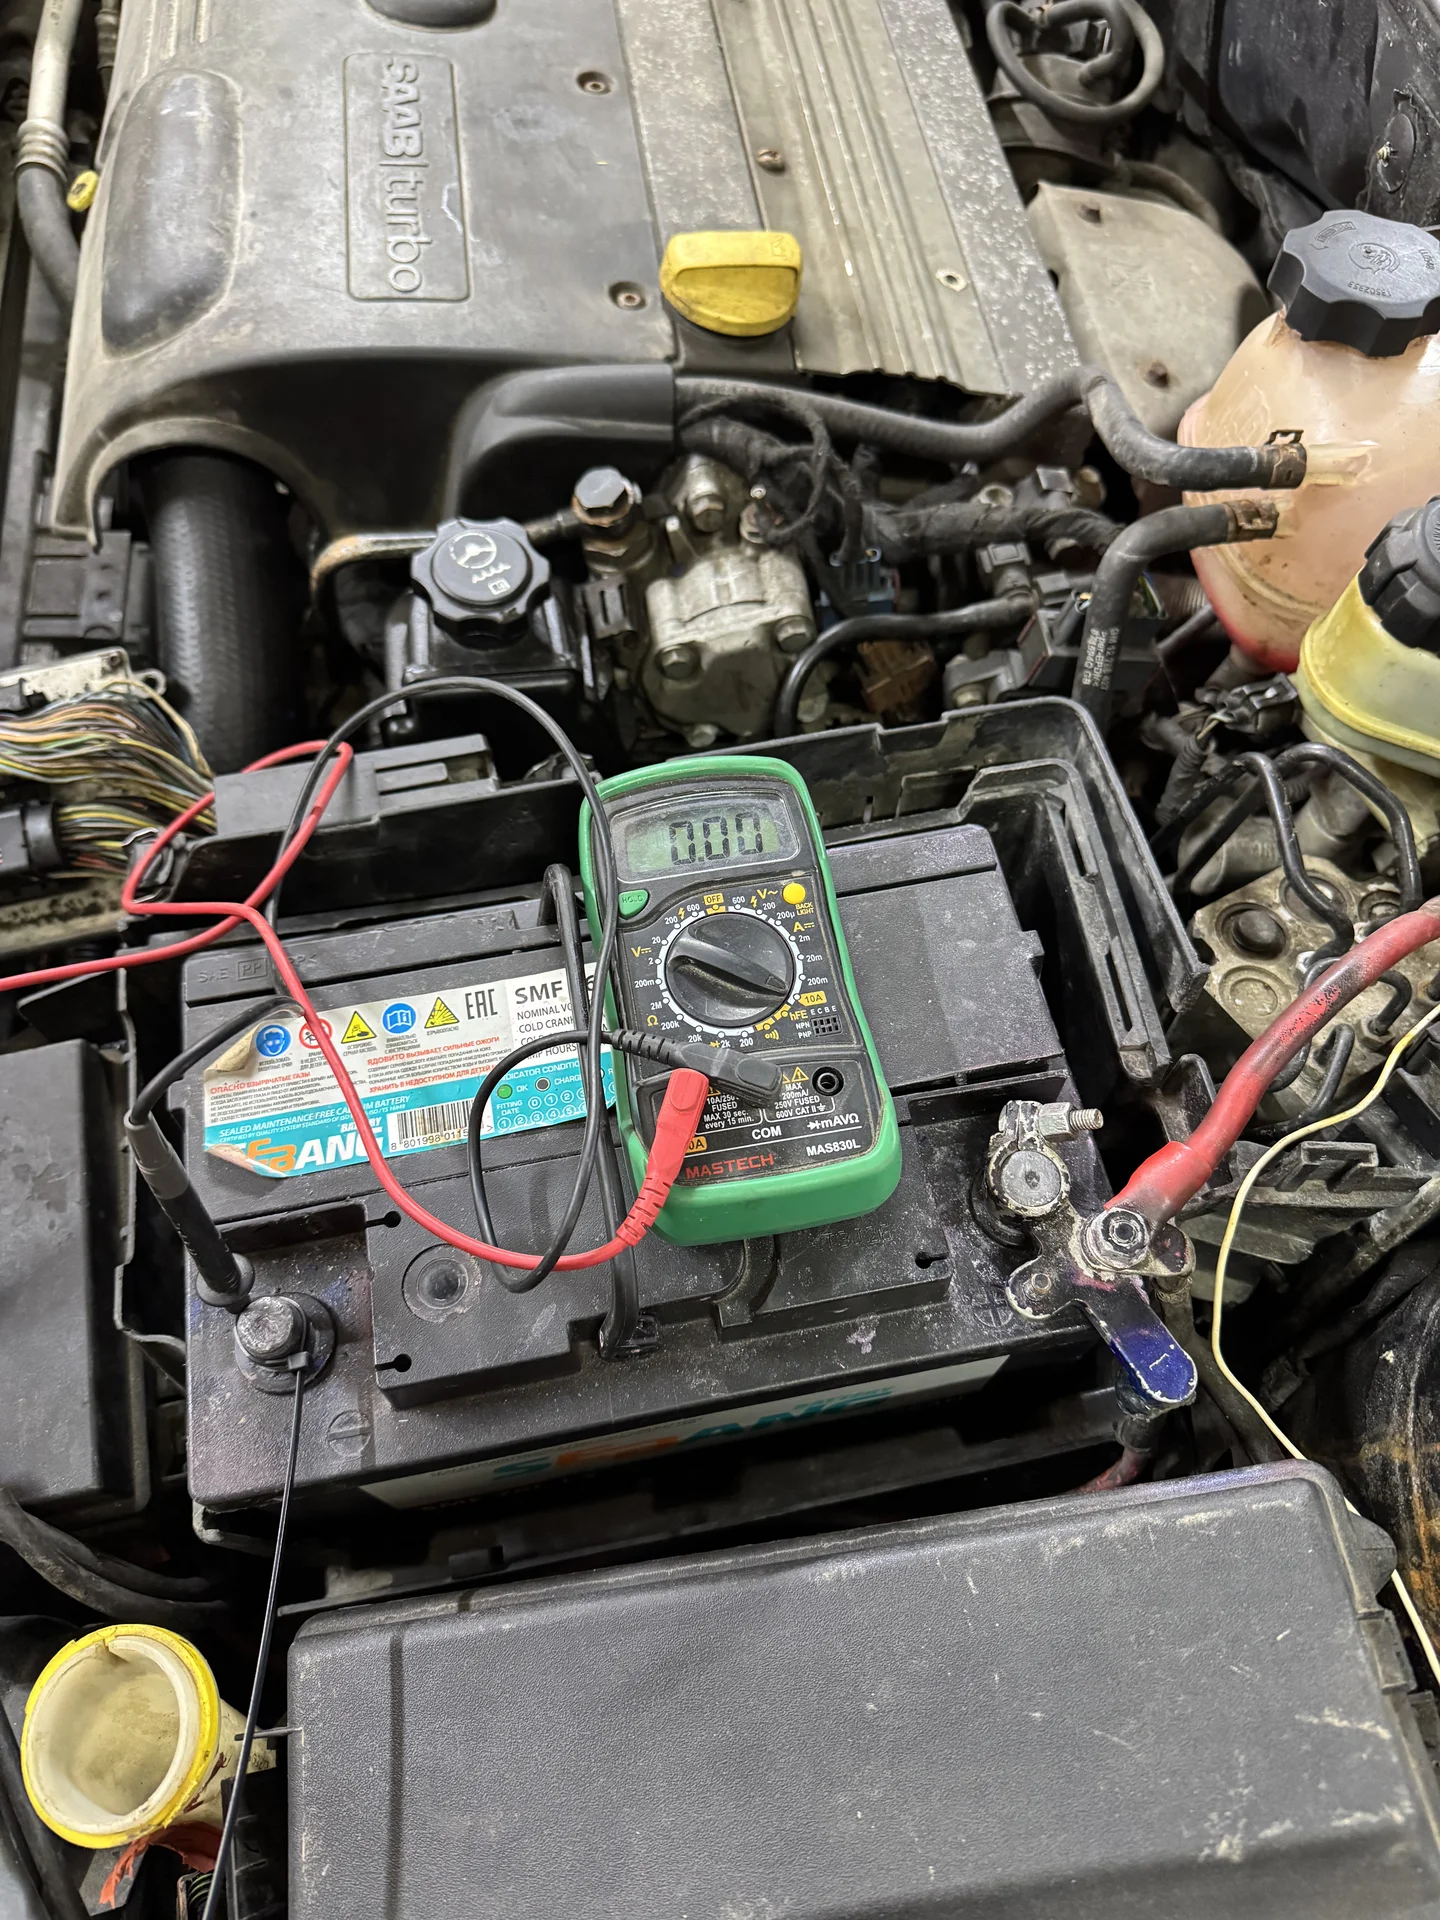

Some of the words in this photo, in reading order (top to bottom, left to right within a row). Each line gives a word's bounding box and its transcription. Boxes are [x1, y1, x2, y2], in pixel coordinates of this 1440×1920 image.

[379, 57, 424, 158] SAAB
[382, 171, 435, 293] turbo
[669, 812, 762, 865] 0.00
[706, 894, 721, 903] OFF
[732, 896, 745, 905] 600
[687, 903, 700, 912] 600
[763, 902, 775, 911] 200
[797, 907, 814, 915] LIGHT
[664, 916, 678, 925] 200
[652, 937, 661, 945] 20
[799, 934, 810, 942] 2m
[649, 957, 654, 965] 2
[806, 953, 822, 962] 20m
[635, 979, 655, 988] 200m
[808, 976, 828, 986] 200m
[514, 980, 563, 1004] SMF
[805, 994, 822, 1004] 10A
[650, 1002, 662, 1010] 2M
[516, 1005, 559, 1020] NOMINAL
[789, 1010, 808, 1021] hFE
[518, 1021, 543, 1033] COLD
[661, 1020, 679, 1030] 200k
[796, 1021, 810, 1030] NPN
[688, 1034, 702, 1043] 20k
[798, 1030, 812, 1038] PNP
[721, 1039, 730, 1048] 2k
[740, 1038, 754, 1047] 200
[367, 1053, 405, 1066] ЯДОВИТО
[406, 1046, 442, 1058] ВЫЗЫВАЕТ
[443, 1041, 475, 1051] СИЛЬНЫЕ
[476, 1036, 499, 1045] ОЖОГИ
[369, 1083, 398, 1093] ХРАНИТЬ
[405, 1072, 454, 1086] НЕДОСТУПНОМ
[455, 1069, 469, 1077] ДЛЯ
[470, 1065, 490, 1074] ДЕТЕЙ
[210, 1081, 245, 1094] ОПАСНО
[515, 1084, 528, 1092] OK
[785, 1083, 802, 1091] MAX
[496, 1099, 523, 1110] FITTING
[711, 1101, 737, 1111] FUSED
[774, 1100, 793, 1109] 250V
[794, 1095, 820, 1105] FUSED
[219, 1124, 251, 1137] SEALED
[252, 1113, 314, 1131] MAINTENANCE
[314, 1109, 335, 1119] FREE
[374, 1094, 411, 1108] BATTERY
[501, 1107, 519, 1115] DATE
[703, 1112, 720, 1121] MAX
[722, 1110, 731, 1118] 30
[733, 1109, 748, 1117] sec.
[776, 1110, 794, 1119] 600V
[795, 1108, 809, 1116] CAT
[705, 1120, 725, 1130] every
[727, 1117, 736, 1125] 15
[737, 1114, 753, 1123] min.
[751, 1125, 782, 1140] COM
[390, 1142, 397, 1150] 8
[403, 1134, 440, 1147] 801998
[237, 1128, 384, 1173] EBANG
[685, 1154, 774, 1178] MASTECH
[806, 1139, 861, 1157] MAS830L
